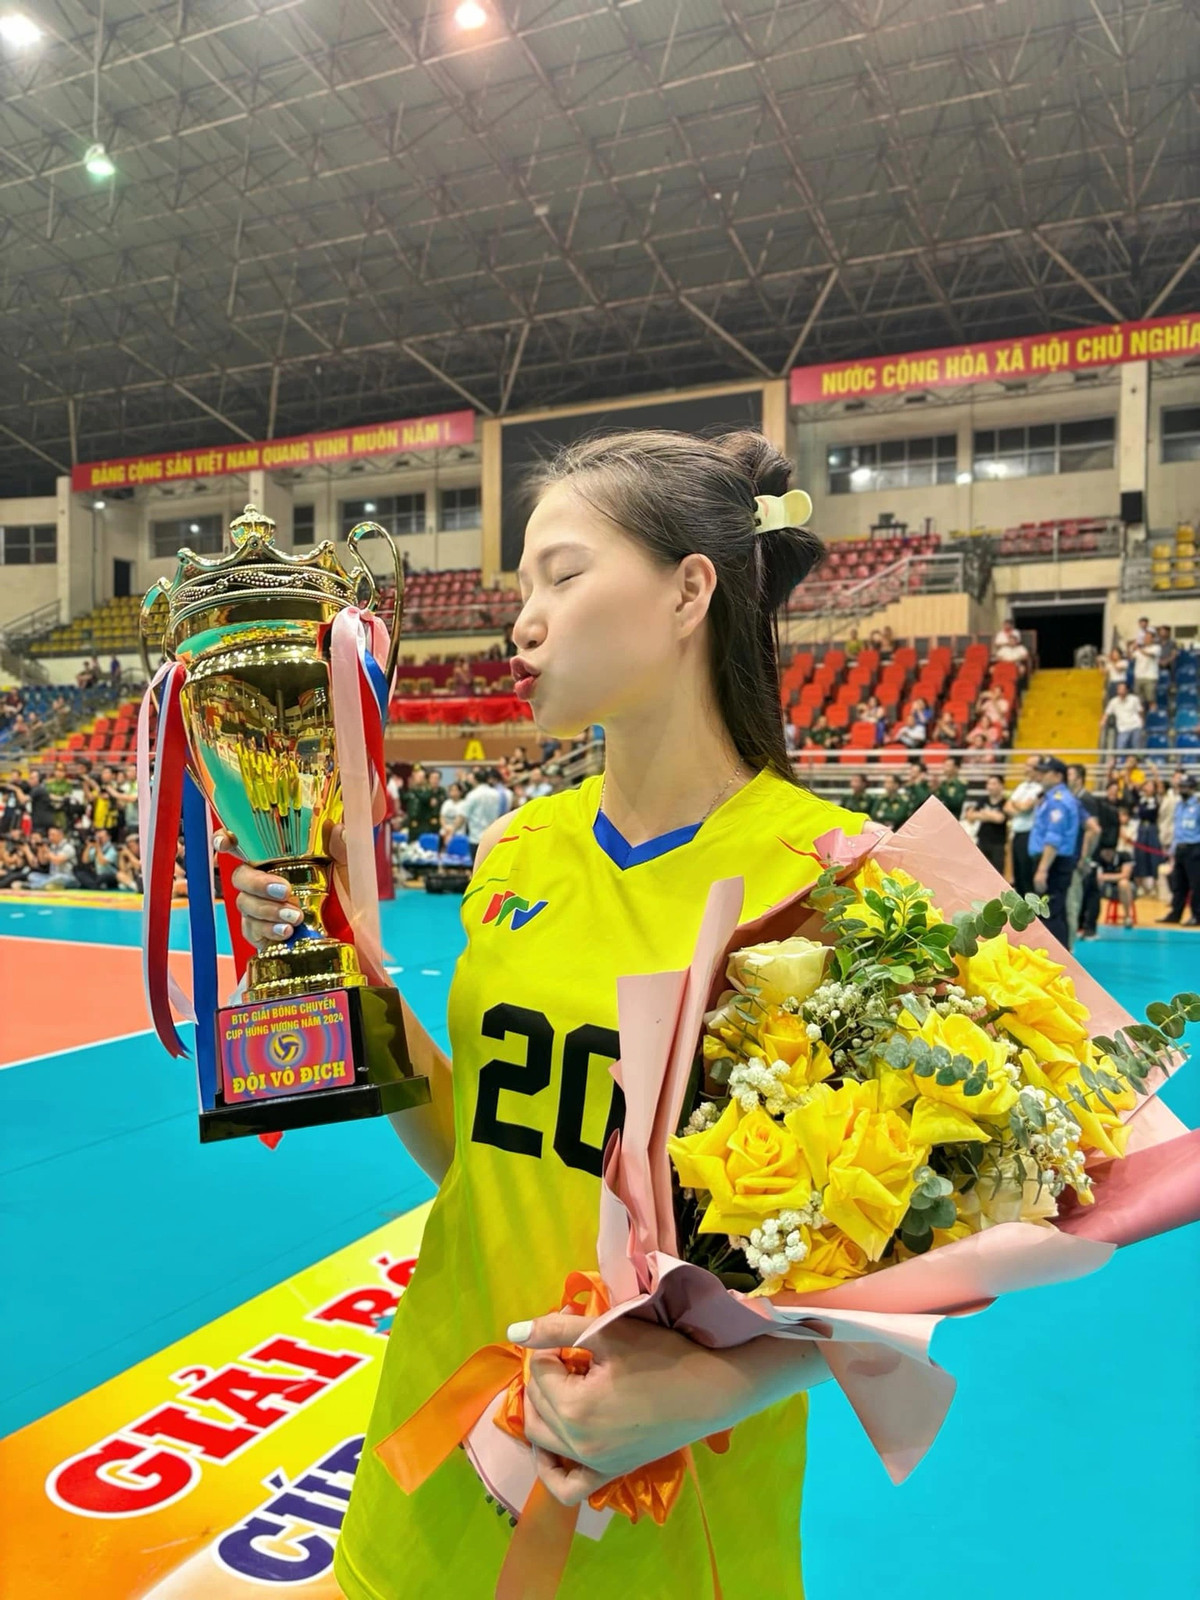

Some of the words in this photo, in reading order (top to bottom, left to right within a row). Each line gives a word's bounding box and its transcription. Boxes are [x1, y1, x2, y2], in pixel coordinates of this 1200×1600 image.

[822, 365, 877, 396] NƯỚC
[882, 358, 939, 391] CỘNG
[945, 348, 989, 380] HÒA
[995, 344, 1026, 374] XÃ
[1031, 338, 1069, 371] HỘI
[1076, 325, 1123, 362] CHỦ
[128, 459, 163, 484] CỘNG
[165, 452, 192, 478] SẢN
[195, 451, 223, 475] VIỆT
[226, 449, 259, 469] NAM
[262, 442, 310, 467] QUANG
[314, 435, 349, 458] VINH
[352, 427, 399, 453] MUÔN
[464, 740, 485, 760] A
[231, 1013, 250, 1026] BTC
[323, 1012, 344, 1024] 2024
[232, 1072, 267, 1095] ĐỘI
[270, 1066, 296, 1088] VÔ
[300, 1060, 346, 1085] ĐỊCH
[471, 1002, 627, 1178] 20
[52, 1337, 367, 1515] GIẢI
